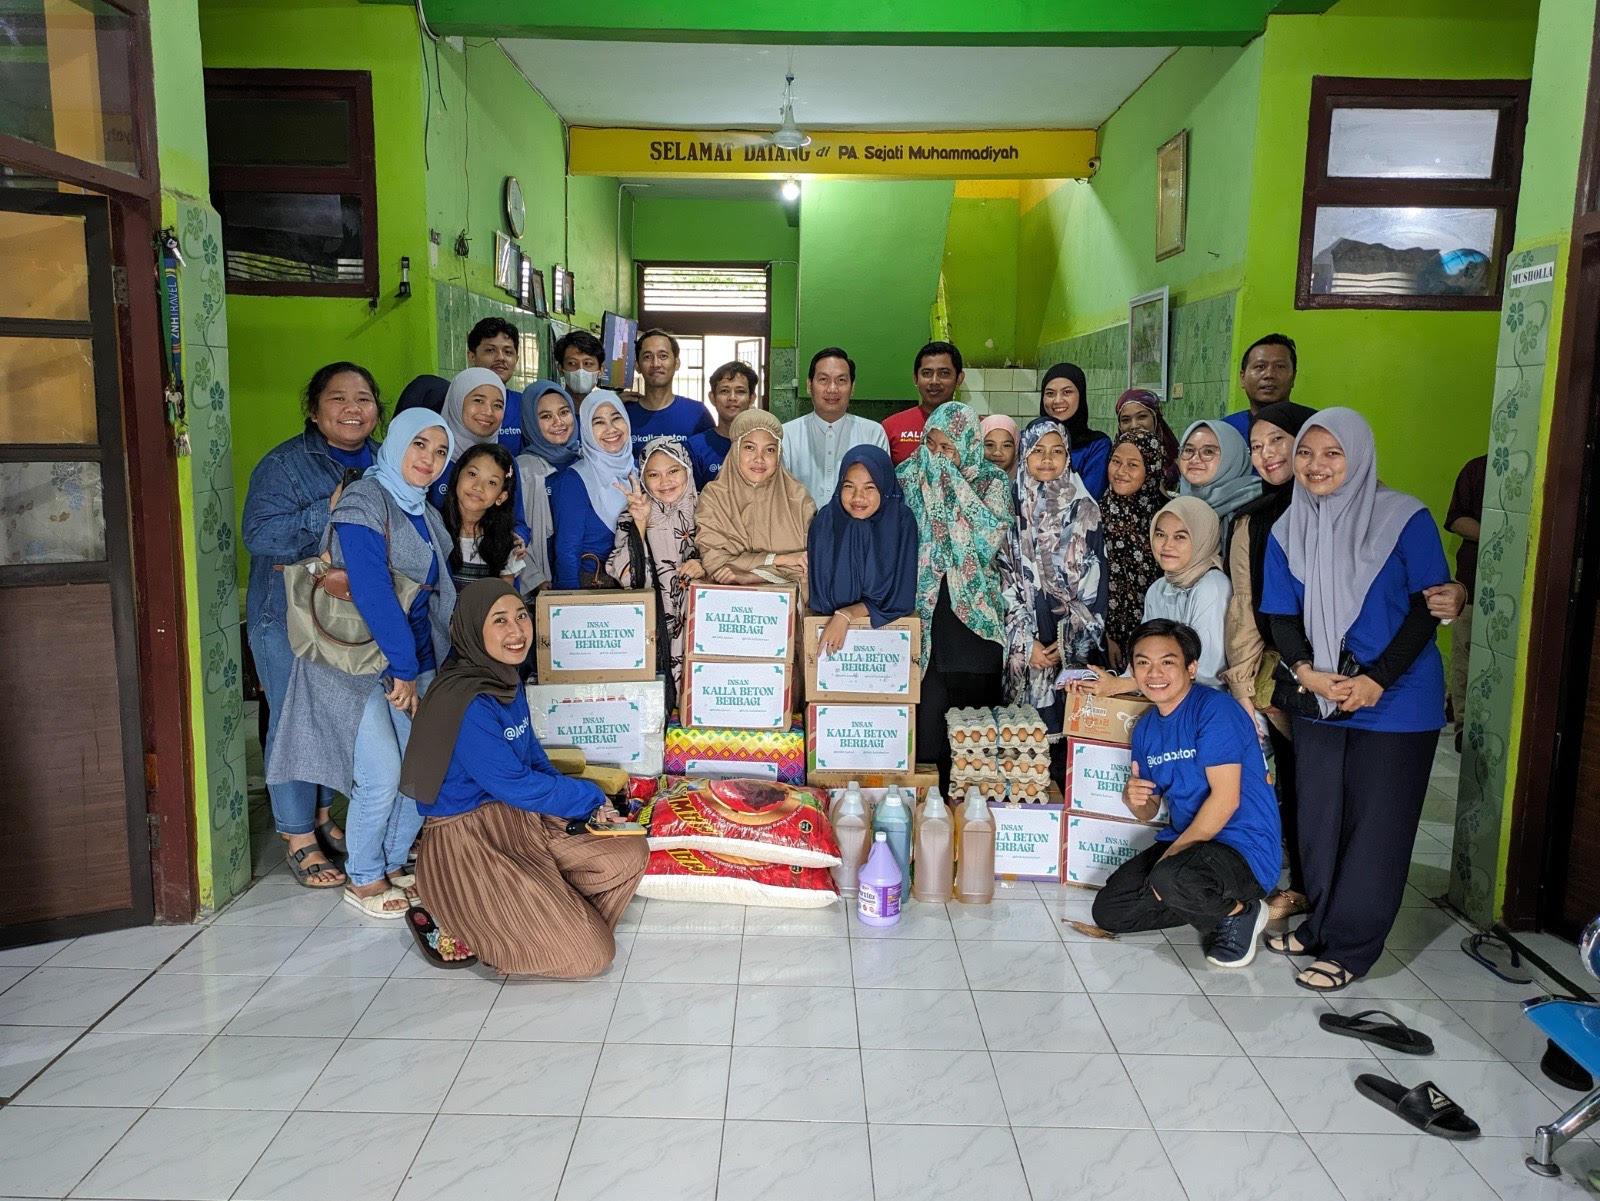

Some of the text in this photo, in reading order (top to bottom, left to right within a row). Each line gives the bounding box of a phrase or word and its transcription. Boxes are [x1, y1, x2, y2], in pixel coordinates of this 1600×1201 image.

[650, 141, 733, 162] SELAMAT
[744, 142, 809, 162] DATANG
[864, 145, 903, 162] Sejati
[908, 145, 1019, 163] Muhammadiyah
[1512, 266, 1553, 285] MUSHOLLA
[731, 606, 753, 614] INSAN
[705, 612, 778, 625] KALLA BETON
[587, 621, 609, 629] INSAN
[719, 623, 764, 635] BERBAGI
[561, 628, 635, 639] KALLA BETON
[575, 639, 621, 649] BERBAGI
[828, 653, 863, 662] KALLA
[866, 653, 900, 663] BETON
[841, 663, 886, 673] BERBAGI
[702, 686, 774, 696] KALLA BETON
[716, 697, 761, 706] BERBAGI
[557, 723, 630, 736] KALLA BETON
[826, 728, 898, 739] KALLA BETON
[571, 734, 617, 745] BERBAGI
[839, 739, 885, 748] BERBAGI
[1083, 768, 1120, 781] KALLA
[1000, 823, 1024, 832] INSAN
[1013, 832, 1049, 843] BETON
[1104, 836, 1129, 847] INSAN
[1078, 840, 1115, 855] KALLA
